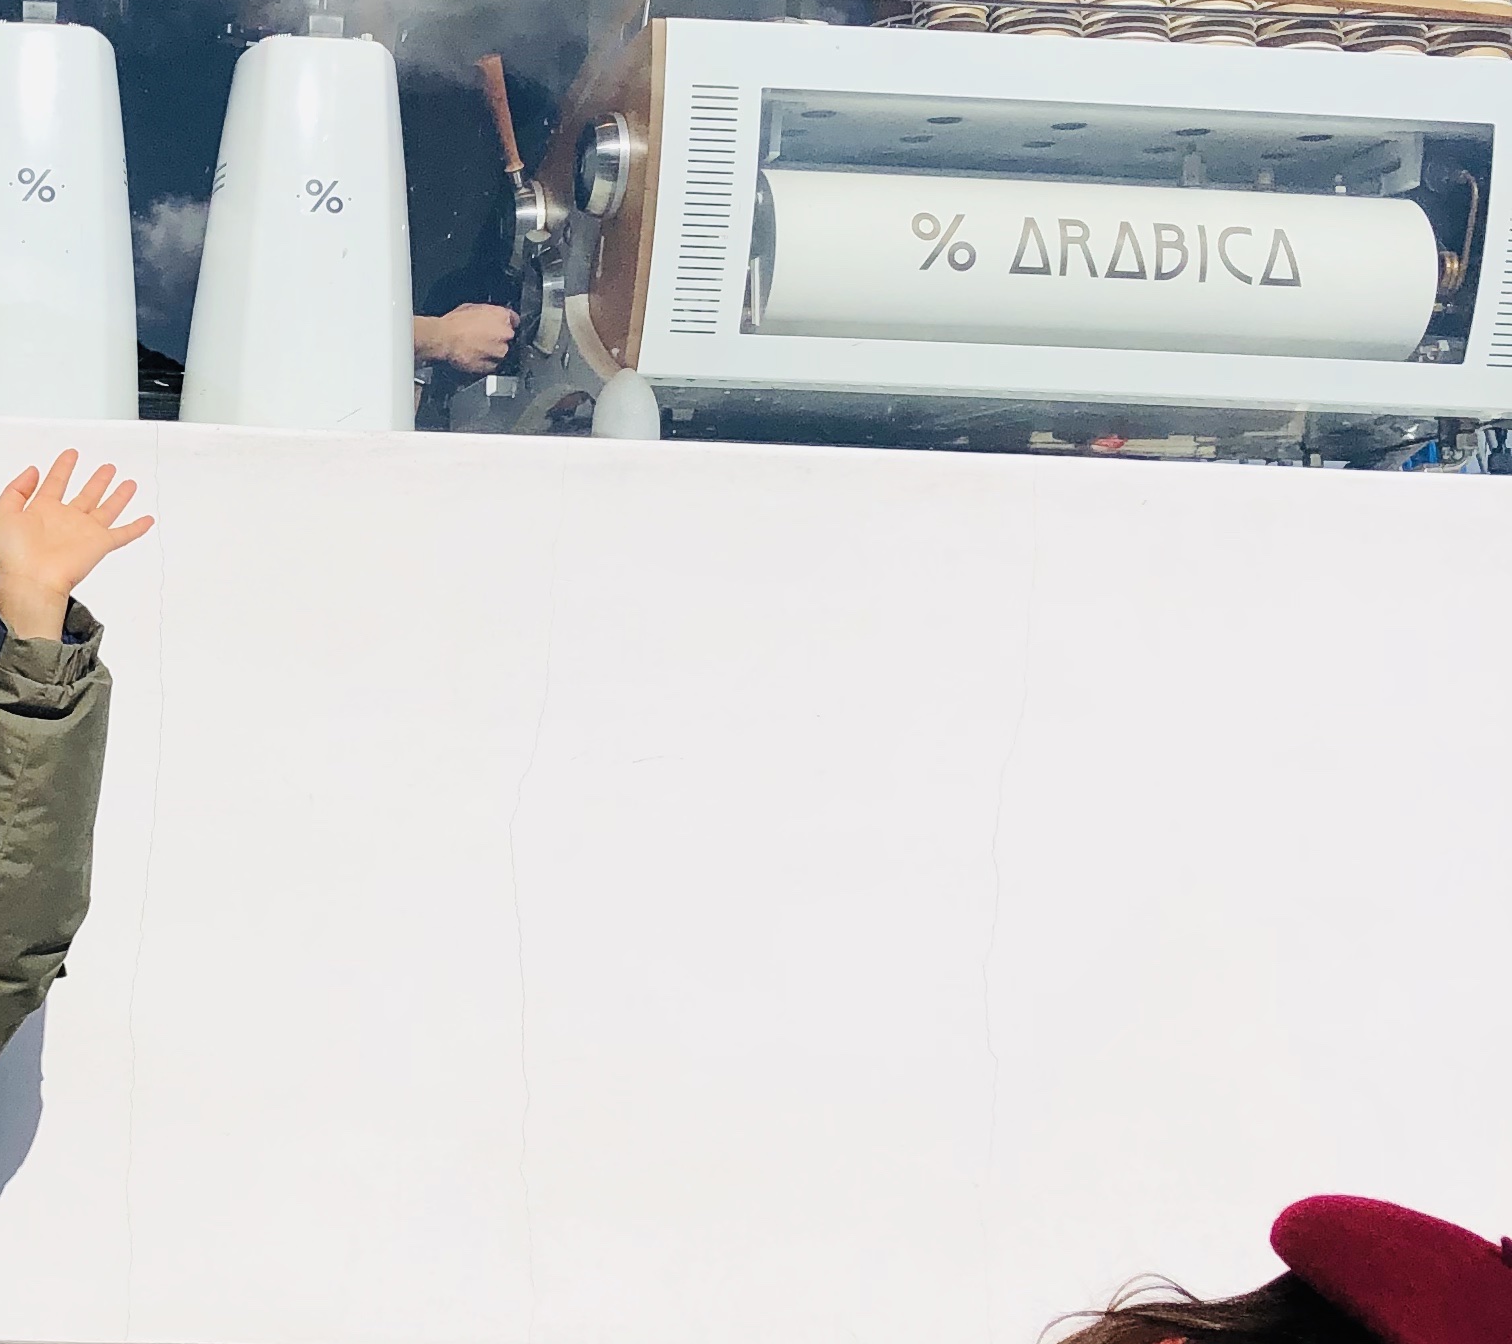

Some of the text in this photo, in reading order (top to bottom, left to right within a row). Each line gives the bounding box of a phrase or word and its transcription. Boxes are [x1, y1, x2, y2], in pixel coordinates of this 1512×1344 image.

[17, 167, 56, 203] %
[305, 178, 344, 214] %
[911, 212, 1302, 288] % ARABICA
